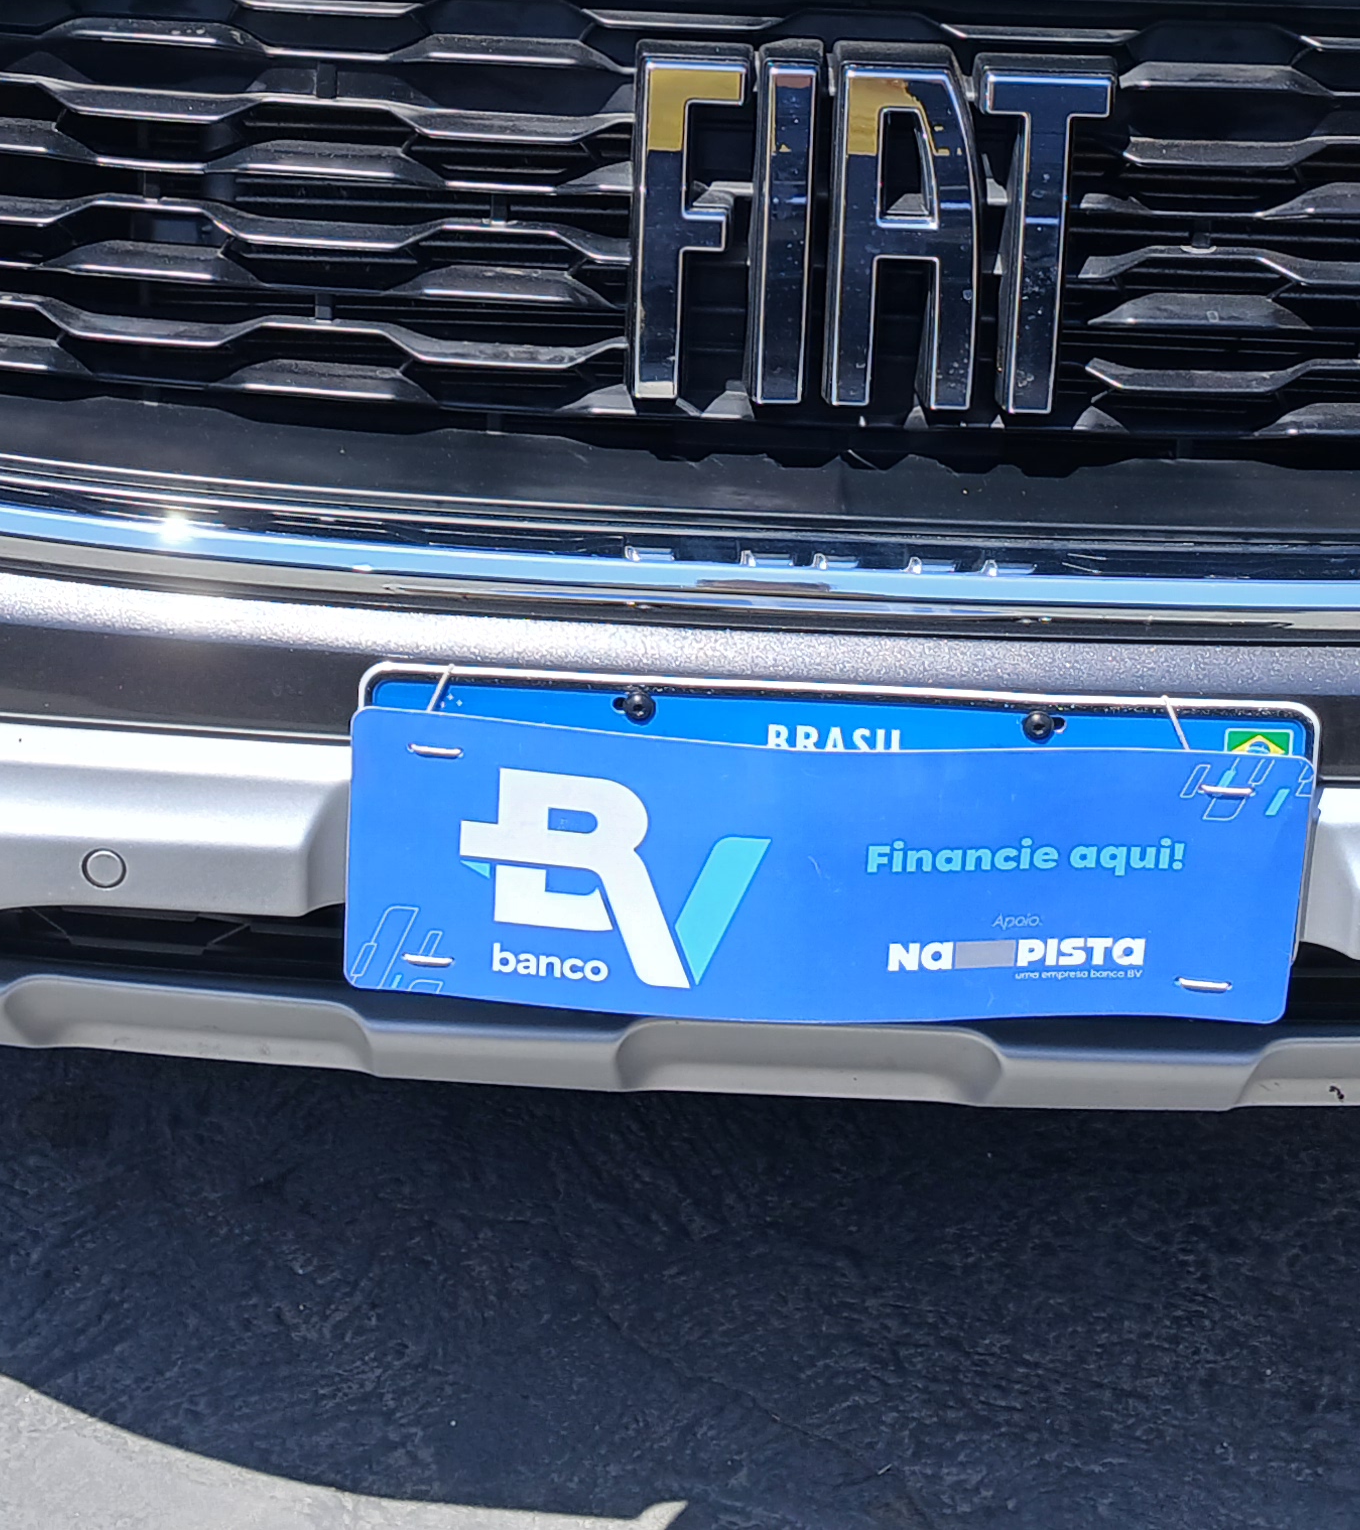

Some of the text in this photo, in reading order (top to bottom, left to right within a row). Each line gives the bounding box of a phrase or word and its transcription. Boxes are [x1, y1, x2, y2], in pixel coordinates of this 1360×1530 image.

[630, 46, 1115, 415] FIAT
[865, 837, 1186, 876] Financie aqui!
[492, 942, 609, 982] banco
[1041, 970, 1089, 981] empresa
